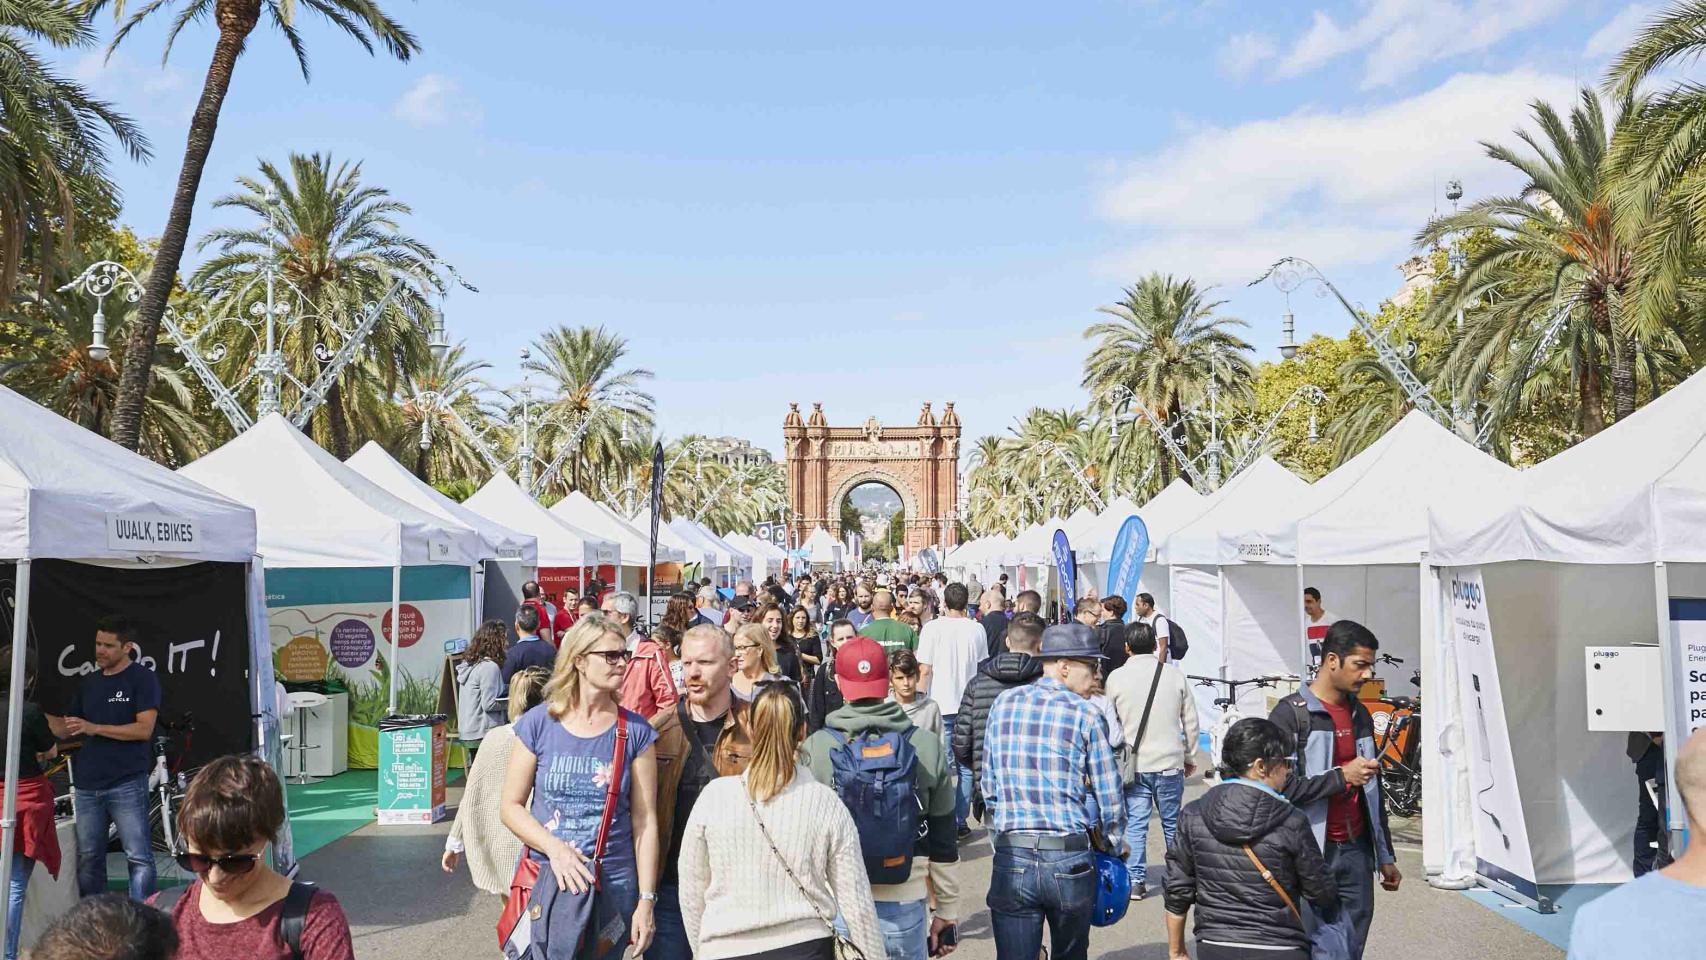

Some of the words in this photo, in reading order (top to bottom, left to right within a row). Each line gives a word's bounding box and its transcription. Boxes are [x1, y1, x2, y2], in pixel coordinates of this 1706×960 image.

[157, 522, 193, 542] EBIKES
[1452, 573, 1481, 609] pluggo
[58, 644, 100, 676] Ca
[1593, 650, 1619, 659] pluggo
